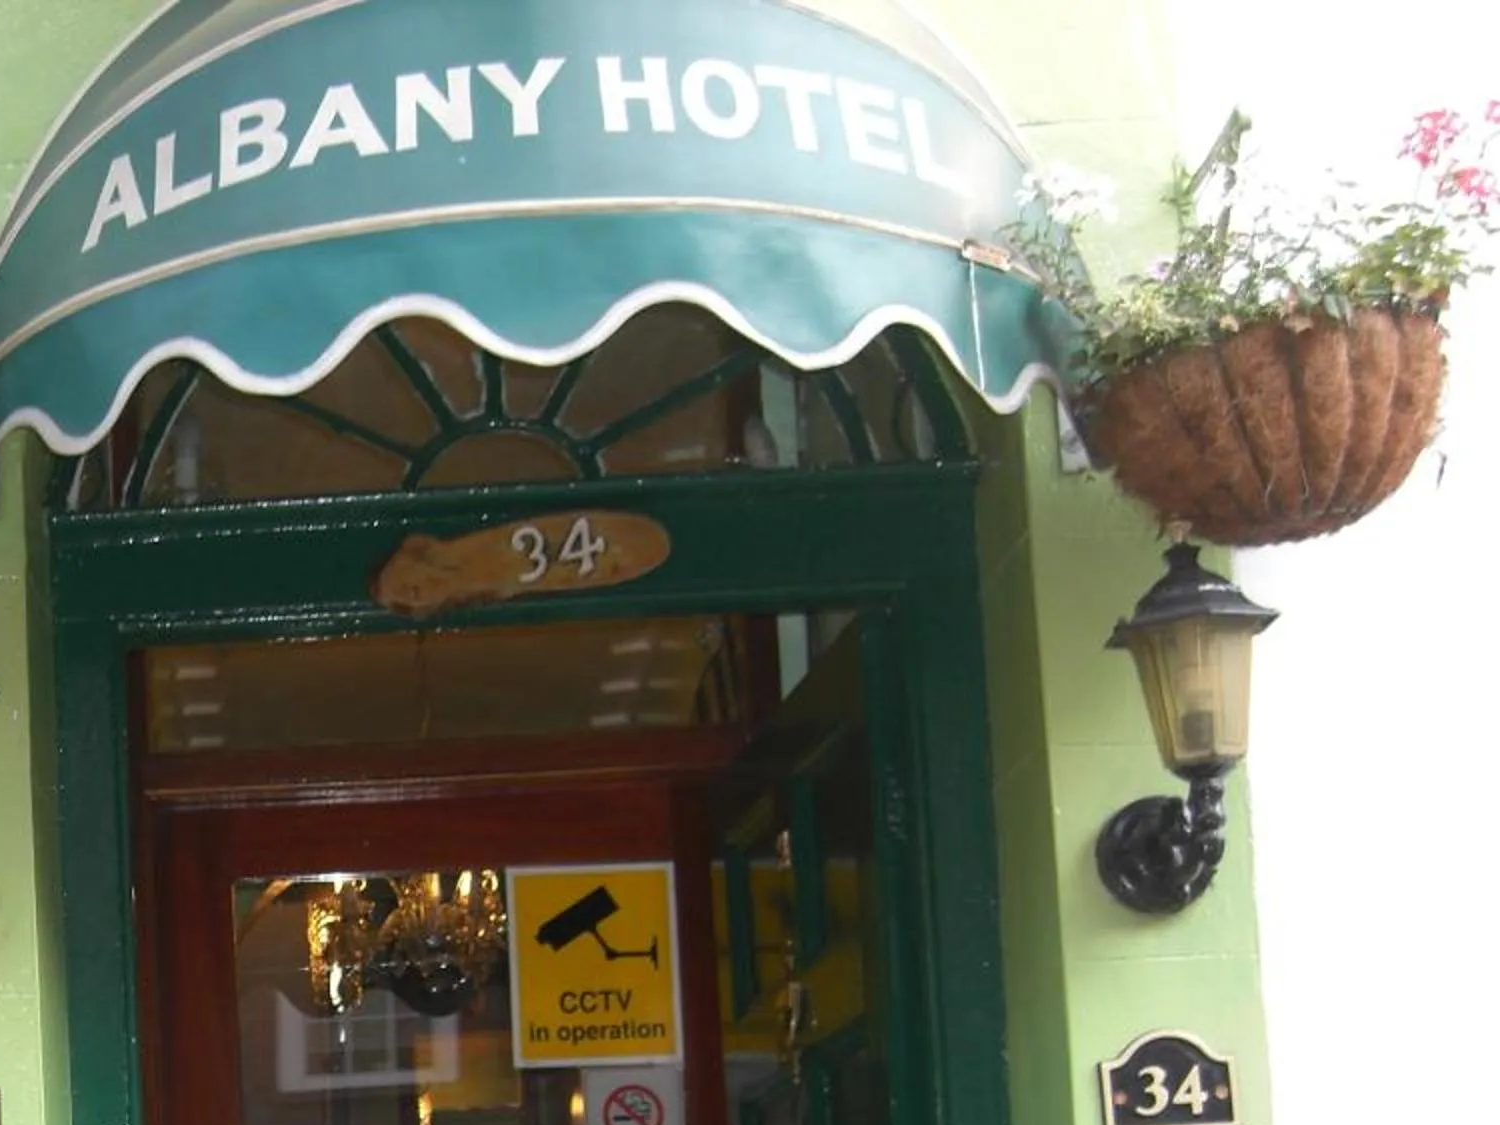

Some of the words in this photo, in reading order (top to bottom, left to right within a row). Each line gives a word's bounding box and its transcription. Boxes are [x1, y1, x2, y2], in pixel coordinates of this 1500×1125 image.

[81, 57, 566, 254] ALBANY
[596, 56, 980, 204] HOTEL
[511, 516, 605, 583] 34
[559, 990, 633, 1014] CCTV
[529, 1021, 549, 1042] in
[557, 1019, 666, 1046] operation
[1135, 1063, 1209, 1117] 34
